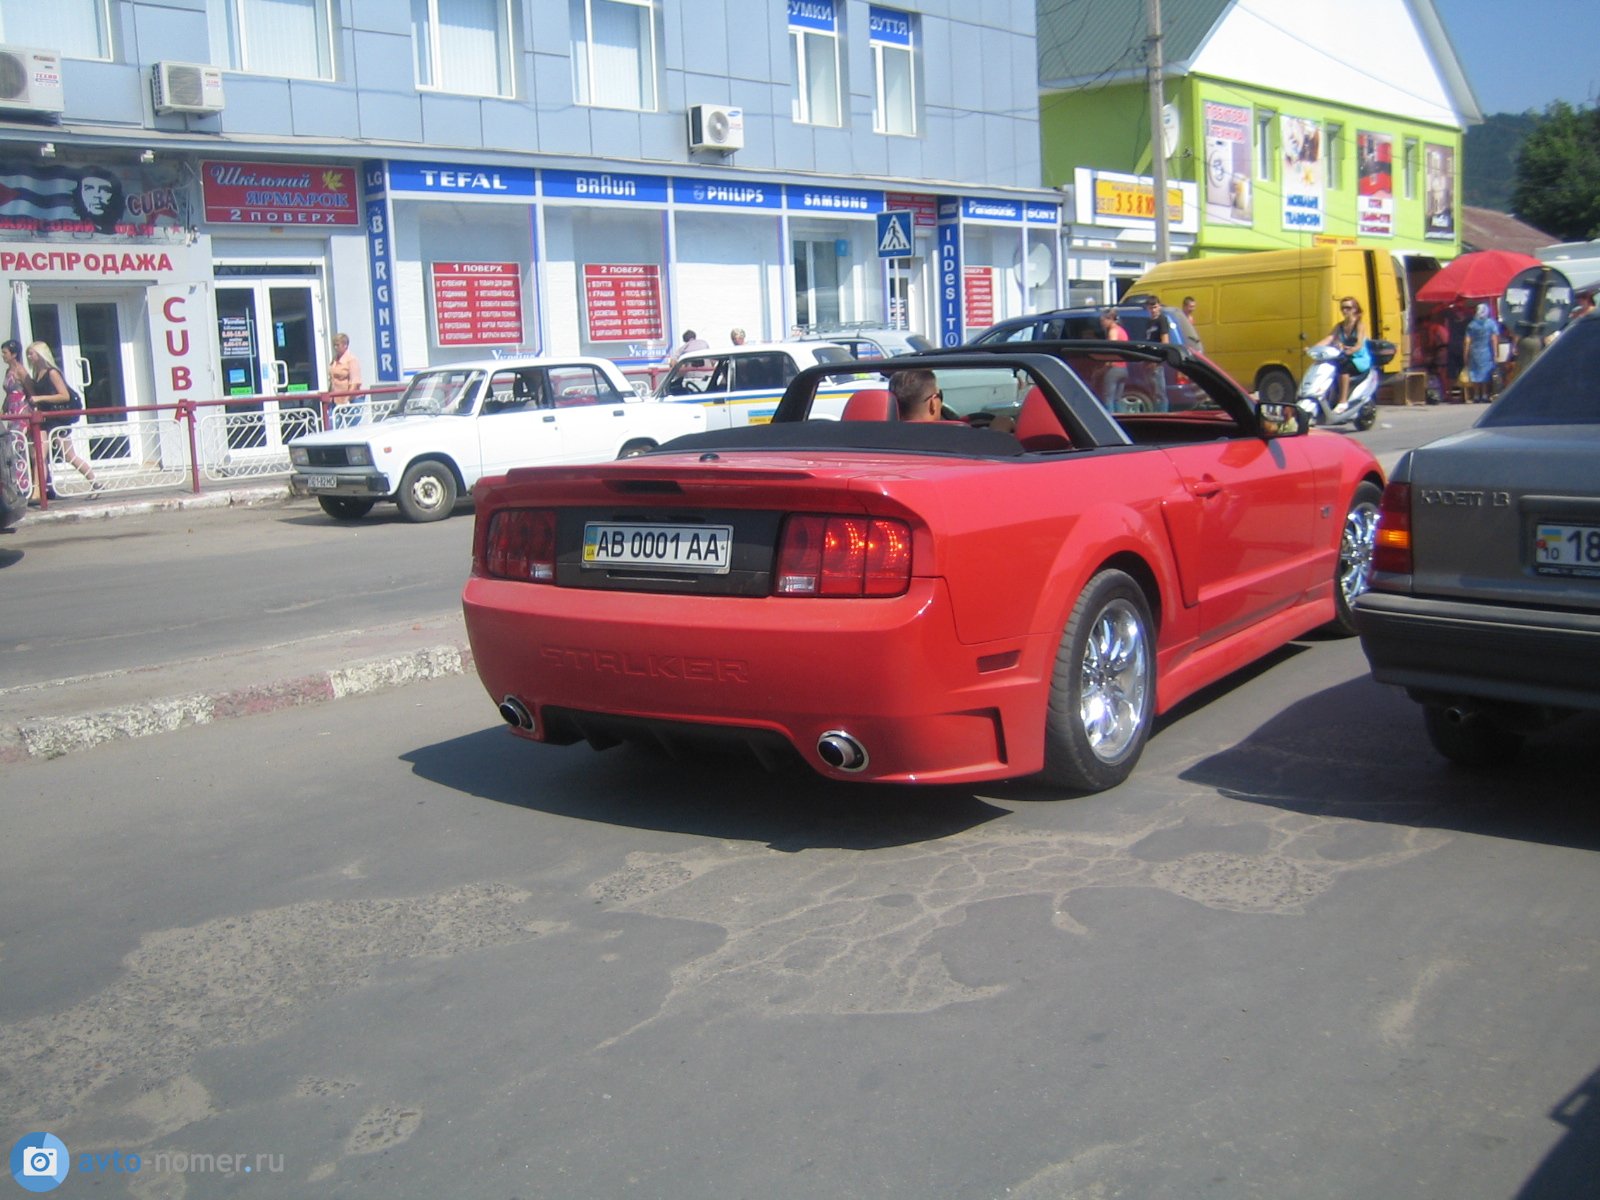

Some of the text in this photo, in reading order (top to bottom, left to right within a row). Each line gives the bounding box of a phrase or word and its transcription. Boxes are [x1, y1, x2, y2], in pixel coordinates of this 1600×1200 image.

[210, 165, 312, 188] Шкільний
[366, 171, 383, 187] LG
[420, 169, 508, 190] TEFAL
[576, 174, 636, 197] BRAUN
[126, 188, 179, 217] CUBA
[245, 191, 349, 208] ЯРМАРОК
[707, 186, 764, 203] PHILIPS
[804, 193, 868, 210] SAMSUNG
[230, 208, 336, 223] 2 ПОВЕРХ
[1, 251, 174, 274] РАСПРОДАЖА
[453, 263, 503, 273] 1 ПОВЕРХ
[600, 266, 645, 274] 2 ПОВЕРХ
[371, 215, 394, 373] BERGNER
[163, 296, 197, 422] CUBA
[627, 344, 668, 358] Україна
[596, 530, 720, 562] AB 0001 AA
[1544, 547, 1560, 560] 10
[1566, 530, 1600, 563] 18
[540, 647, 749, 684] STALKER
